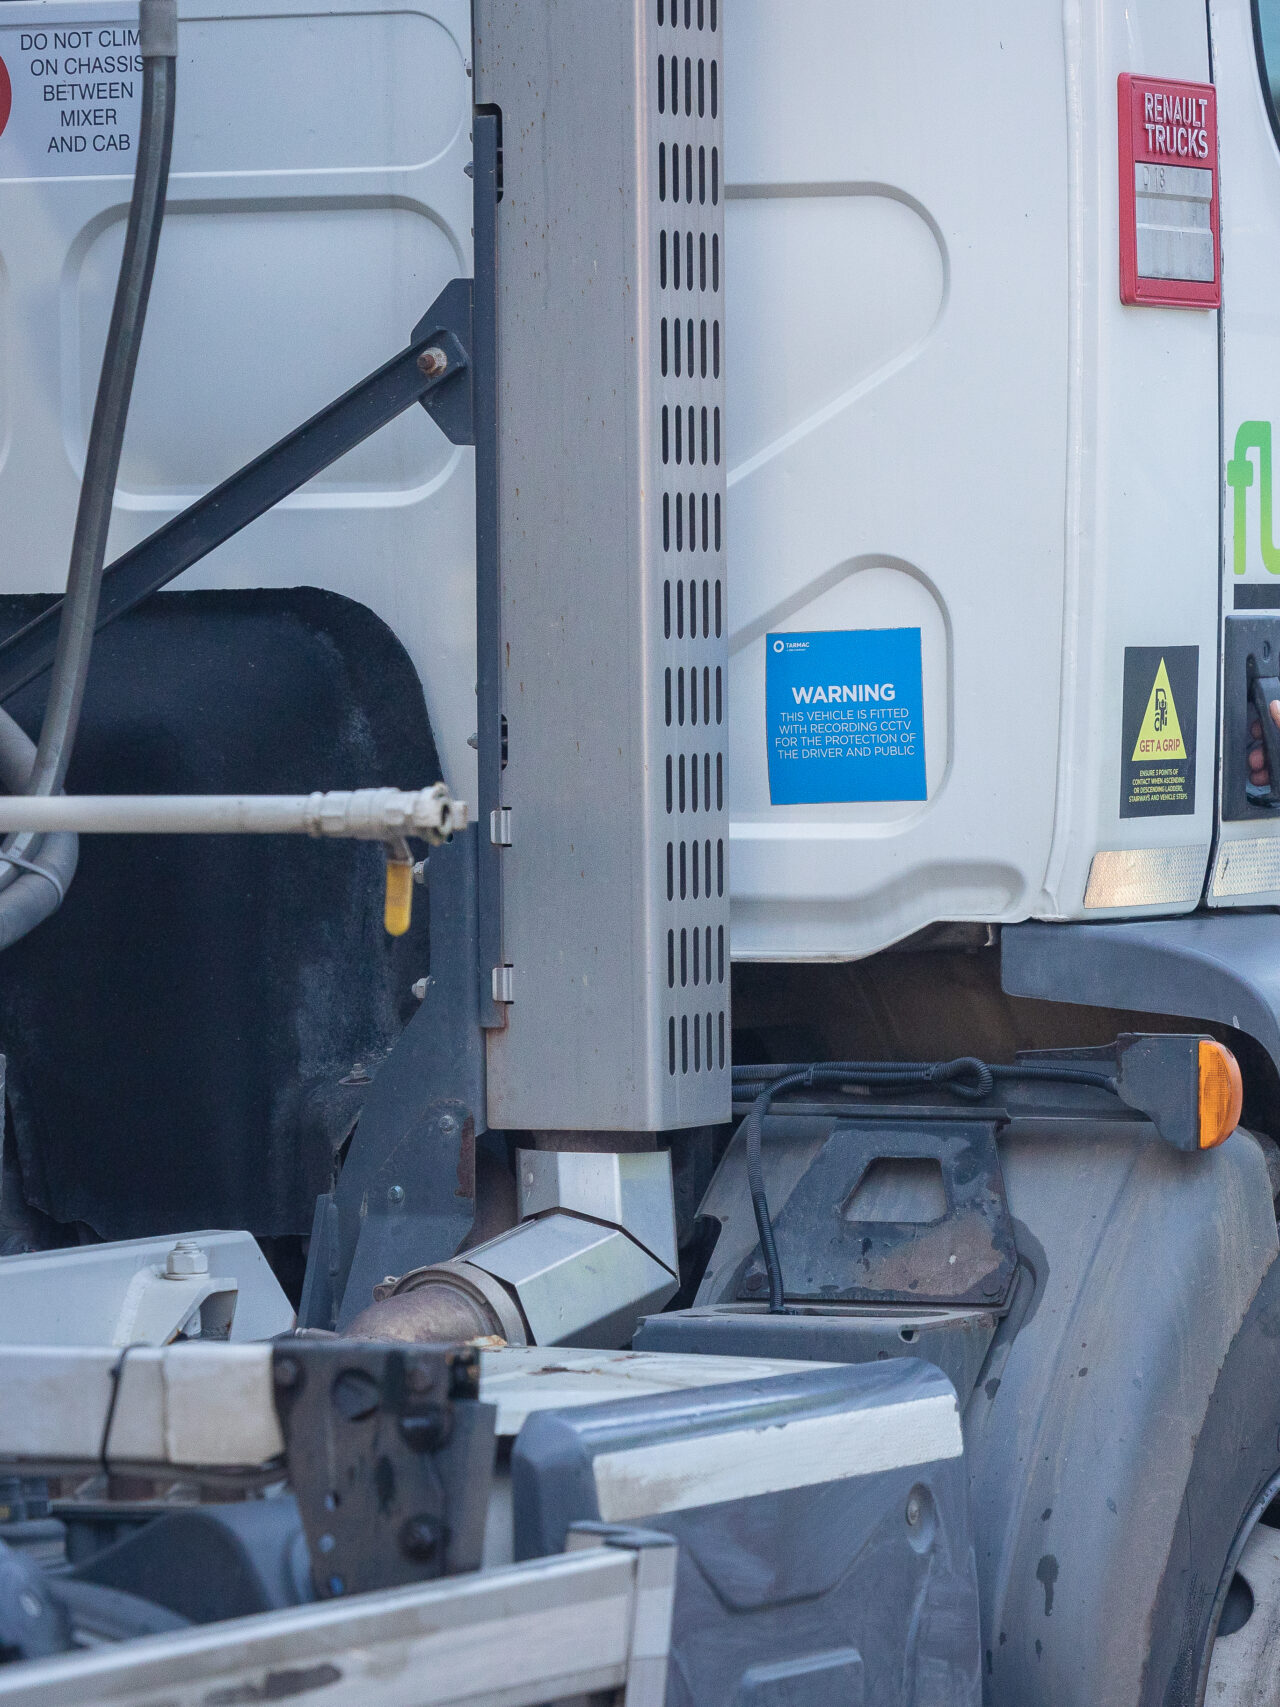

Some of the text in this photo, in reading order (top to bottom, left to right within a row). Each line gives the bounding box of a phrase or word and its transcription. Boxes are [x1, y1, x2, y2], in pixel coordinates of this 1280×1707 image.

[21, 30, 142, 50] DO NOT CLIM
[31, 55, 143, 76] ON CHASSIS
[44, 82, 133, 101] BETWEEN
[61, 109, 117, 126] MIXER
[1145, 93, 1208, 127] RENAULT
[48, 134, 130, 153] AND CAB
[1145, 124, 1208, 158] TRUCKS
[792, 684, 895, 705] WARNING
[781, 708, 908, 722] THIS VEHICLE IS FITTED
[779, 721, 911, 734] WITH RECORDING CCTV
[775, 733, 916, 747] FOR THE PROTECTION OF
[1140, 739, 1180, 752] GET A GRIP
[778, 746, 915, 759] THE DRIVER AND PUBLIC
